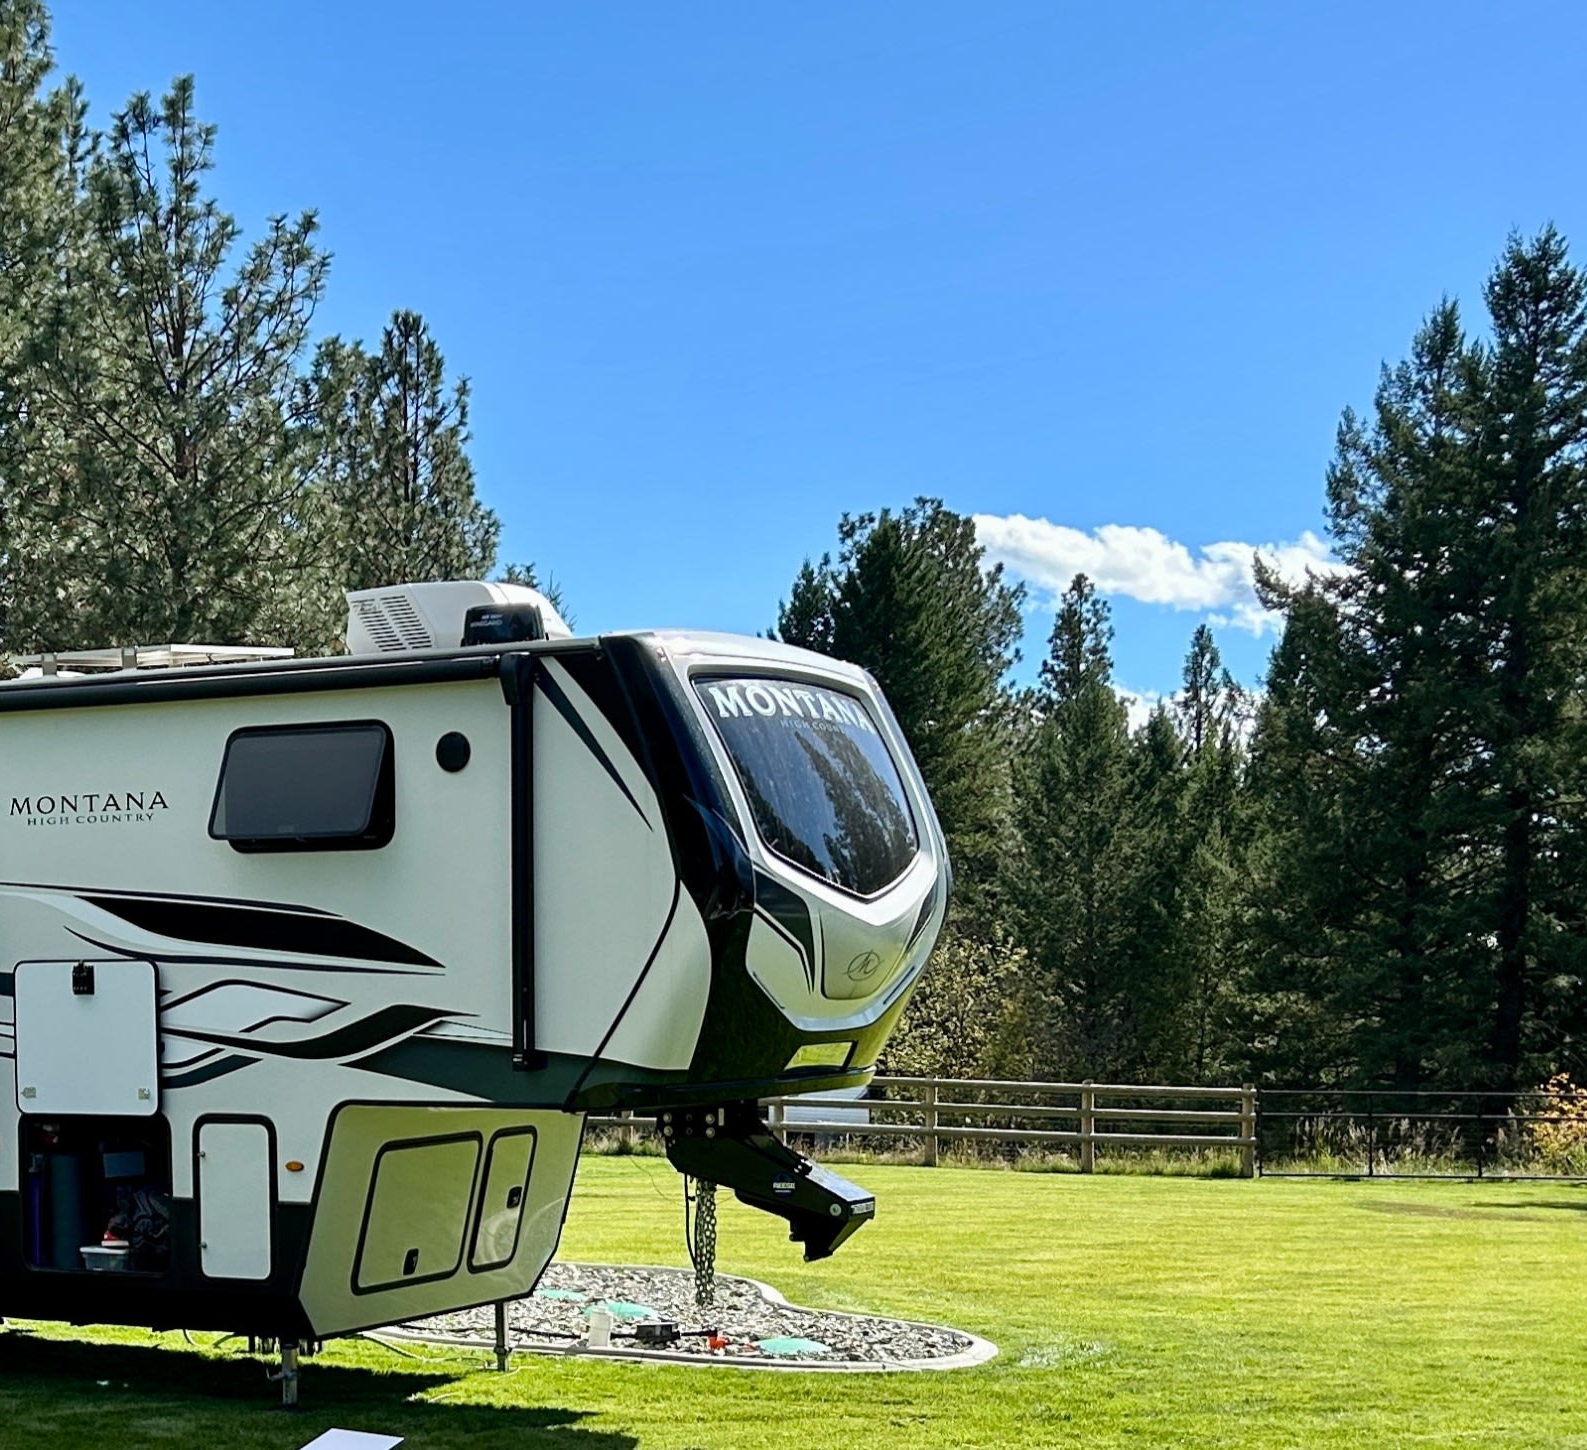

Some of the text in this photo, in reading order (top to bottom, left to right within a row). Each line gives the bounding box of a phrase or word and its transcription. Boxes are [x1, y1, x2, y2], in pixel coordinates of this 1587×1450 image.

[709, 685, 877, 735] MONTANA
[780, 719, 811, 730] HIGH
[9, 791, 169, 816] MONTANA
[27, 813, 155, 826] HIGH COUNTRY
